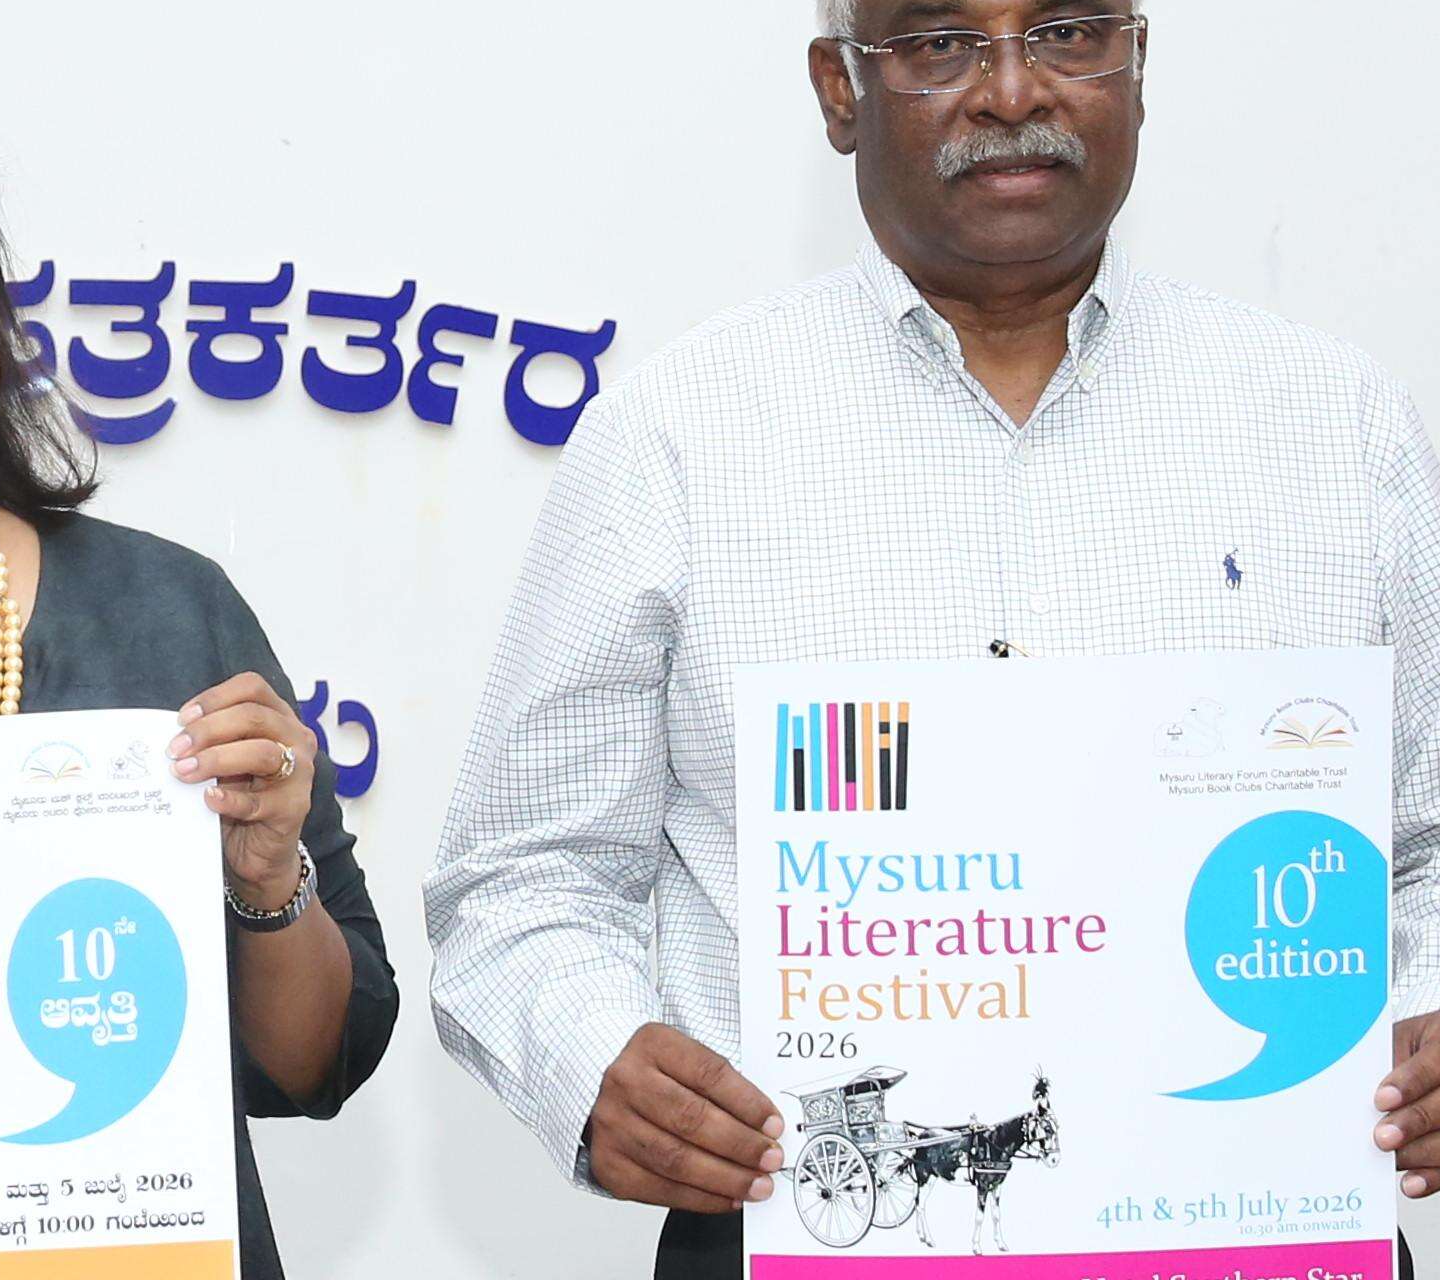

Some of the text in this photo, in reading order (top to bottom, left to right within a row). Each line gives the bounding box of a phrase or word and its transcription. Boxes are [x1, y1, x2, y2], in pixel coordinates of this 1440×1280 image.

[1160, 767, 1347, 783] Mysuru Literary Forum Charitable Trust
[1169, 780, 1341, 795] Mysuru Book Clubs Charitable Trust
[775, 840, 1023, 908] Mysuru
[1253, 839, 1345, 930] 10th
[776, 905, 1106, 957] Literature
[1215, 938, 1367, 981] edition
[778, 964, 1030, 1021] Festival
[40, 991, 138, 1046] ಆವೃತ್ತಿ
[776, 1031, 857, 1058] 2026
[6, 1180, 50, 1205] ಮತ್ತು
[61, 1180, 74, 1196] 5
[84, 1173, 127, 1203] ಜುಲೈ
[136, 1172, 192, 1191] 2026
[1096, 1188, 1362, 1229] 4th & 5th July 2026
[37, 1214, 94, 1234] 10:00
